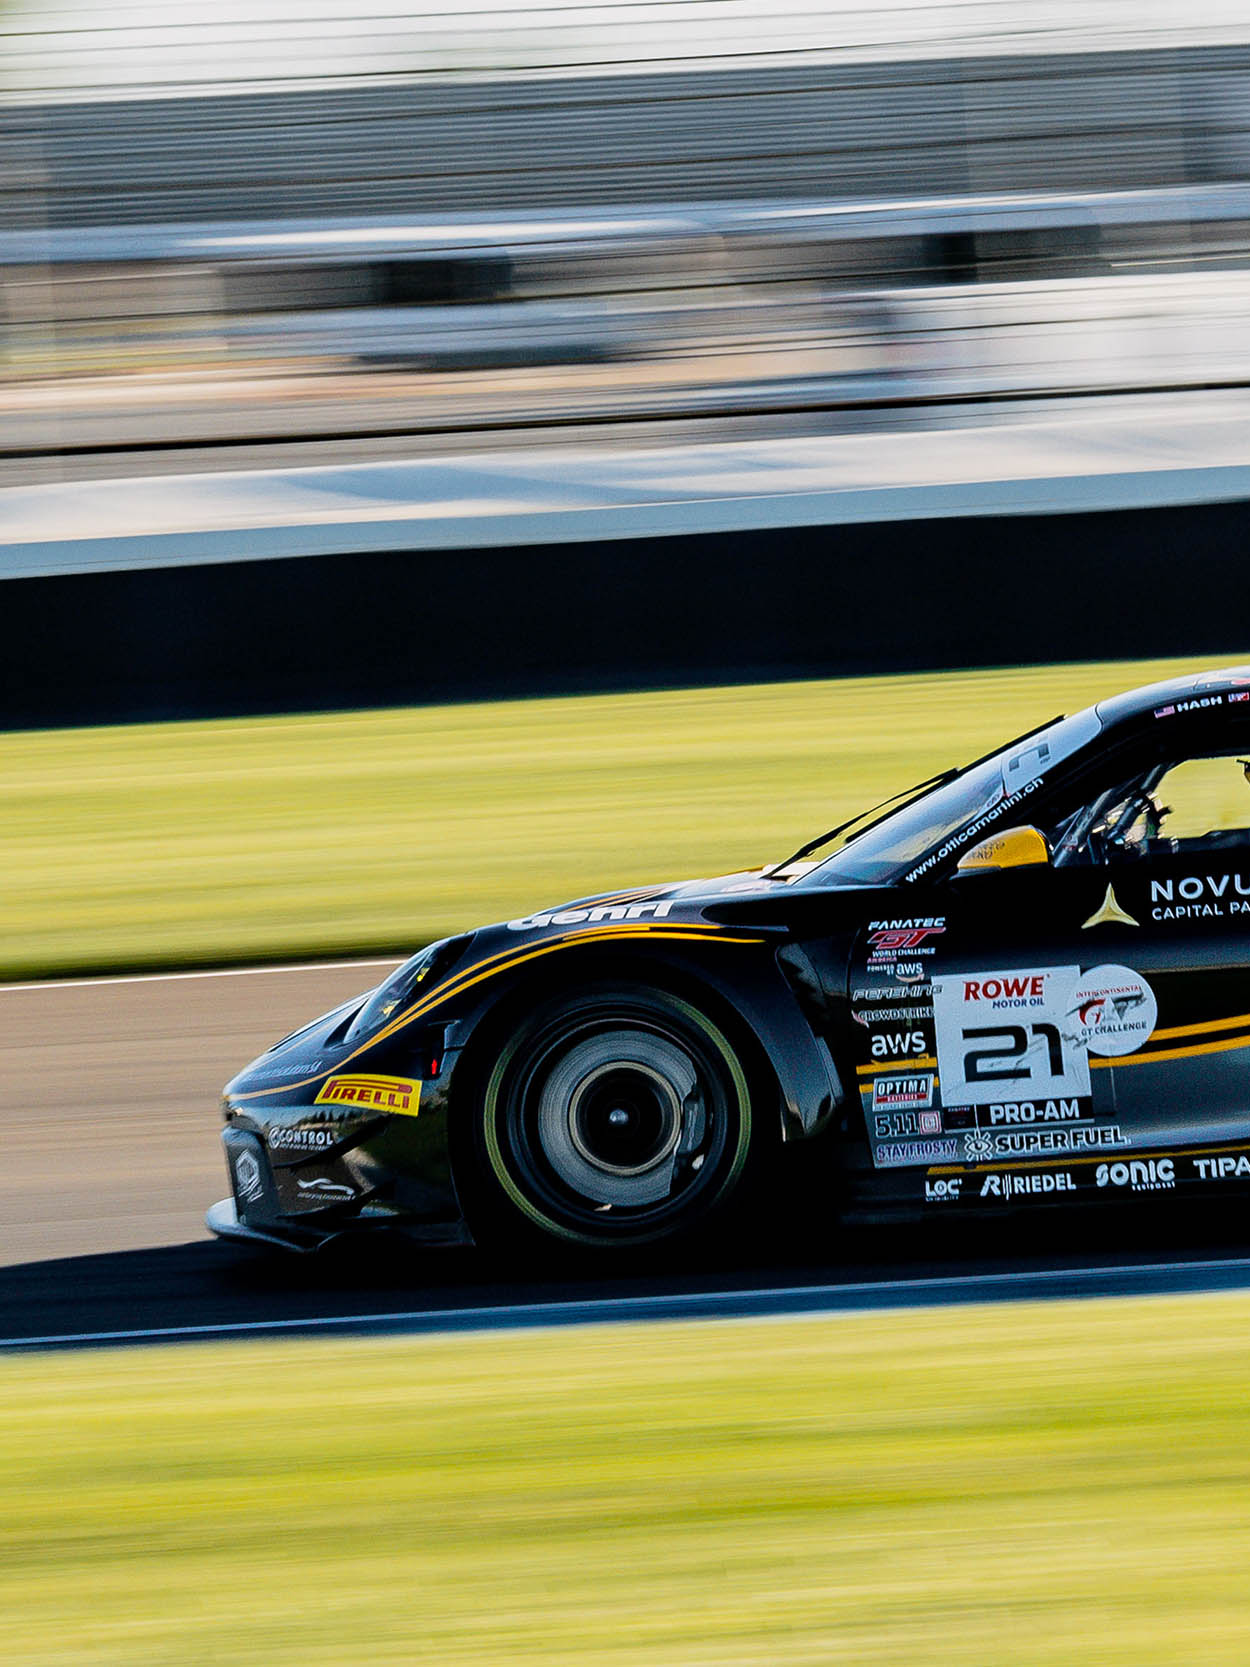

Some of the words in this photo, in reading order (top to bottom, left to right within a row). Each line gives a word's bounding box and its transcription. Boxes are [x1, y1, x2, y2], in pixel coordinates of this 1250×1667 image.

[1152, 903, 1224, 921] CAPITAL
[868, 917, 946, 931] FANATEC
[896, 962, 923, 975] aws
[963, 976, 1044, 1001] ROWE
[992, 1000, 1028, 1009] MOTOR
[1029, 998, 1045, 1006] OIL
[1095, 1021, 1148, 1034] CHALLENGE
[871, 1031, 927, 1056] aws
[962, 1023, 1065, 1084] 21
[322, 1079, 413, 1109] PIRELLI
[878, 1079, 926, 1096] OPTIMA
[990, 1098, 1080, 1125] PRO-AM
[875, 1112, 920, 1138] 5.11
[1013, 1172, 1077, 1195] RIEDEL
